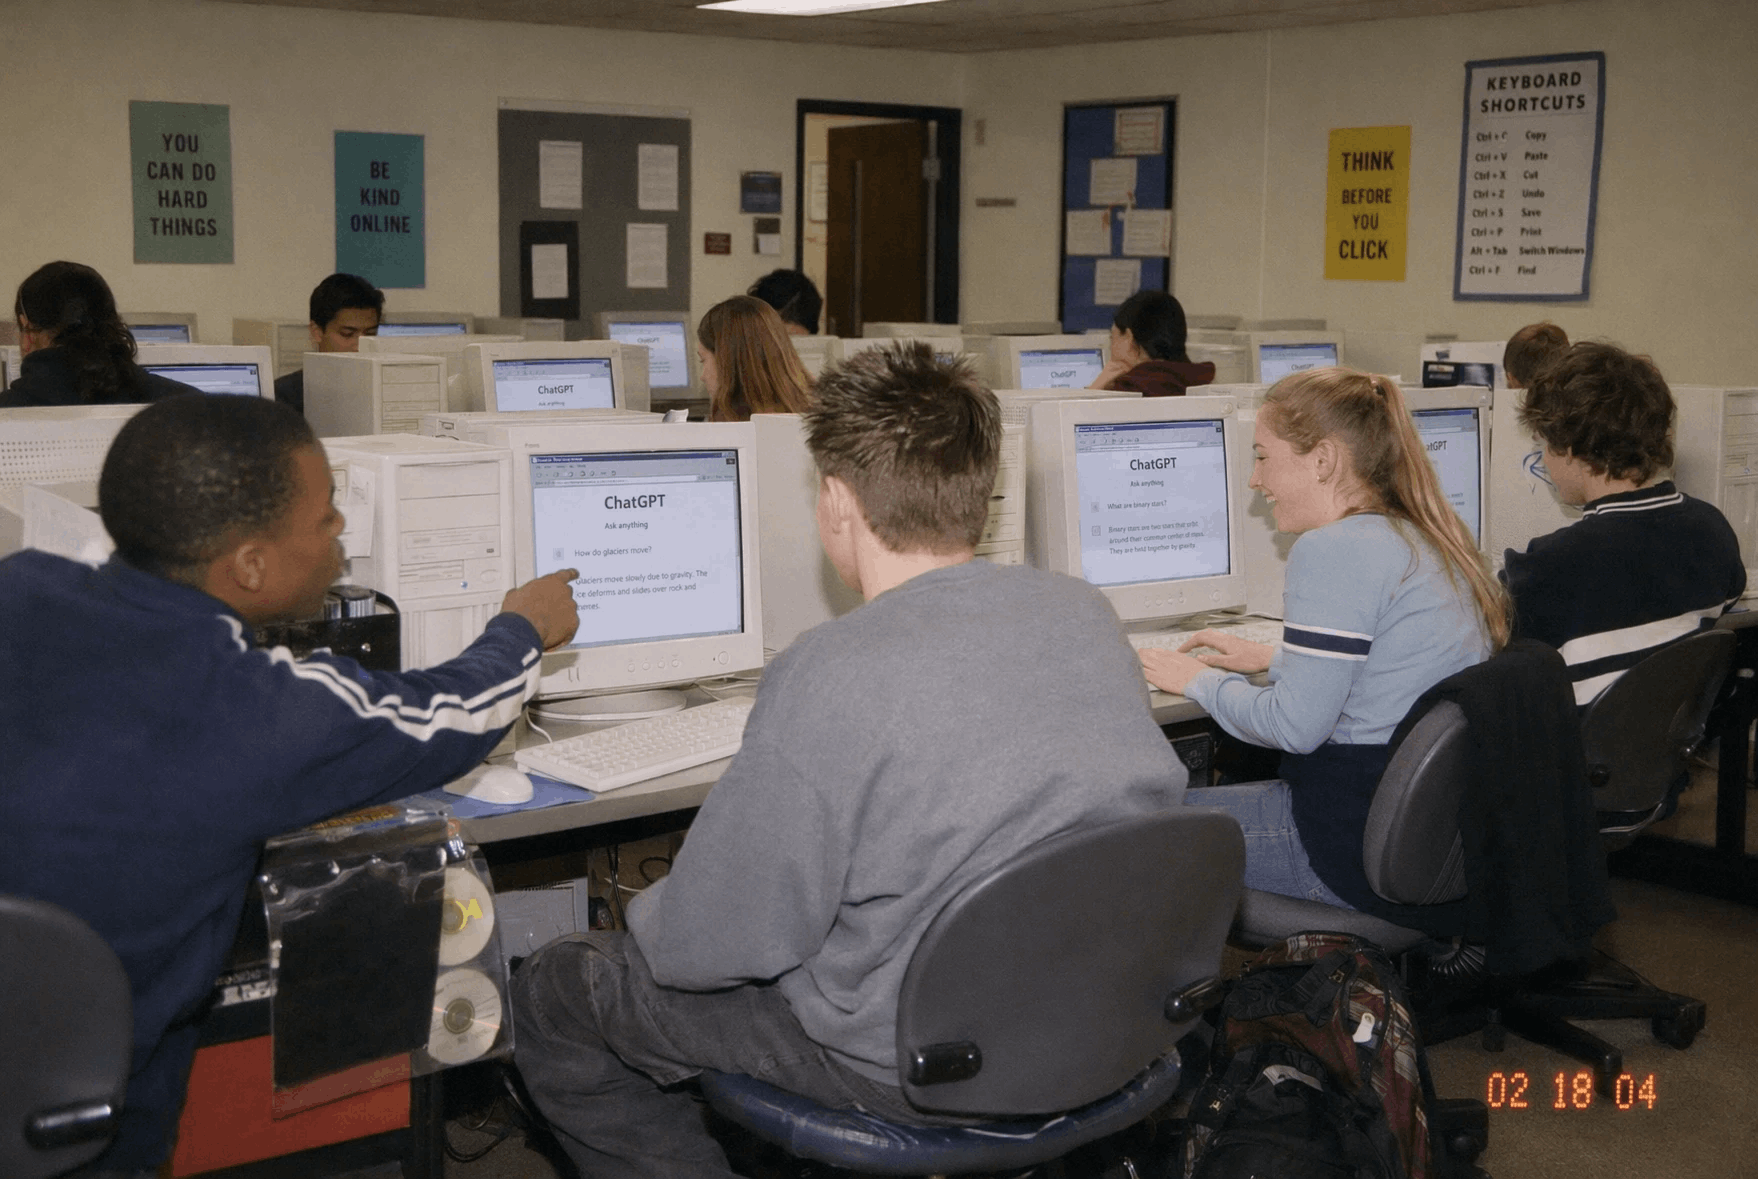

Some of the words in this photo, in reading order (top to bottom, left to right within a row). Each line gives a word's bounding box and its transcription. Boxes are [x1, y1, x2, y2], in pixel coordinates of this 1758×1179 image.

[1487, 72, 1581, 91] KEYBOARD
[1480, 94, 1585, 113] SHORTCUTS
[162, 133, 199, 153] YOU
[1476, 132, 1492, 142] Ctrl
[1525, 130, 1547, 142] Copy
[1341, 150, 1394, 172] THINK
[1475, 153, 1491, 162] Ctrl
[1524, 152, 1548, 160] Paste
[147, 161, 183, 180] CAN
[192, 163, 216, 181] DO
[370, 161, 390, 180] BE
[1474, 171, 1490, 180] Ctrl
[1523, 170, 1538, 180] Cut
[158, 190, 208, 208] HARD
[359, 186, 400, 206] KIND
[1342, 188, 1392, 204] BEFORE
[1473, 190, 1488, 199] Ctrl
[1522, 189, 1545, 198] Undo
[1472, 209, 1488, 218] Ctrl
[1521, 208, 1542, 217] Save
[150, 217, 217, 236] THINGS
[350, 214, 410, 233] ONLINE
[1353, 213, 1379, 230] YOU
[1471, 228, 1487, 237] Ctrl
[1520, 228, 1542, 236] Print
[1339, 239, 1388, 260] CLICK
[1470, 246, 1482, 255] Alt
[1519, 246, 1546, 256] Switch
[1548, 246, 1585, 255] Windows
[1469, 266, 1485, 275] Ctrl
[1518, 266, 1536, 274] Find
[538, 384, 574, 394] ChatGPT
[1426, 440, 1447, 450] atGPT
[1130, 457, 1177, 470] ChatGPT
[1141, 480, 1164, 488] anything
[604, 494, 666, 510] ChatGPT
[604, 521, 617, 530] Ask
[618, 520, 648, 530] anything
[603, 547, 628, 557] glaciers
[630, 546, 652, 554] move?
[604, 575, 624, 583] move
[626, 573, 646, 583] slowly
[647, 572, 660, 580] due
[662, 572, 670, 580] to
[696, 569, 708, 578] The
[588, 588, 616, 598] deforms
[618, 588, 630, 596] and
[632, 586, 651, 595] slides
[668, 584, 682, 592] rock
[684, 583, 696, 591] and
